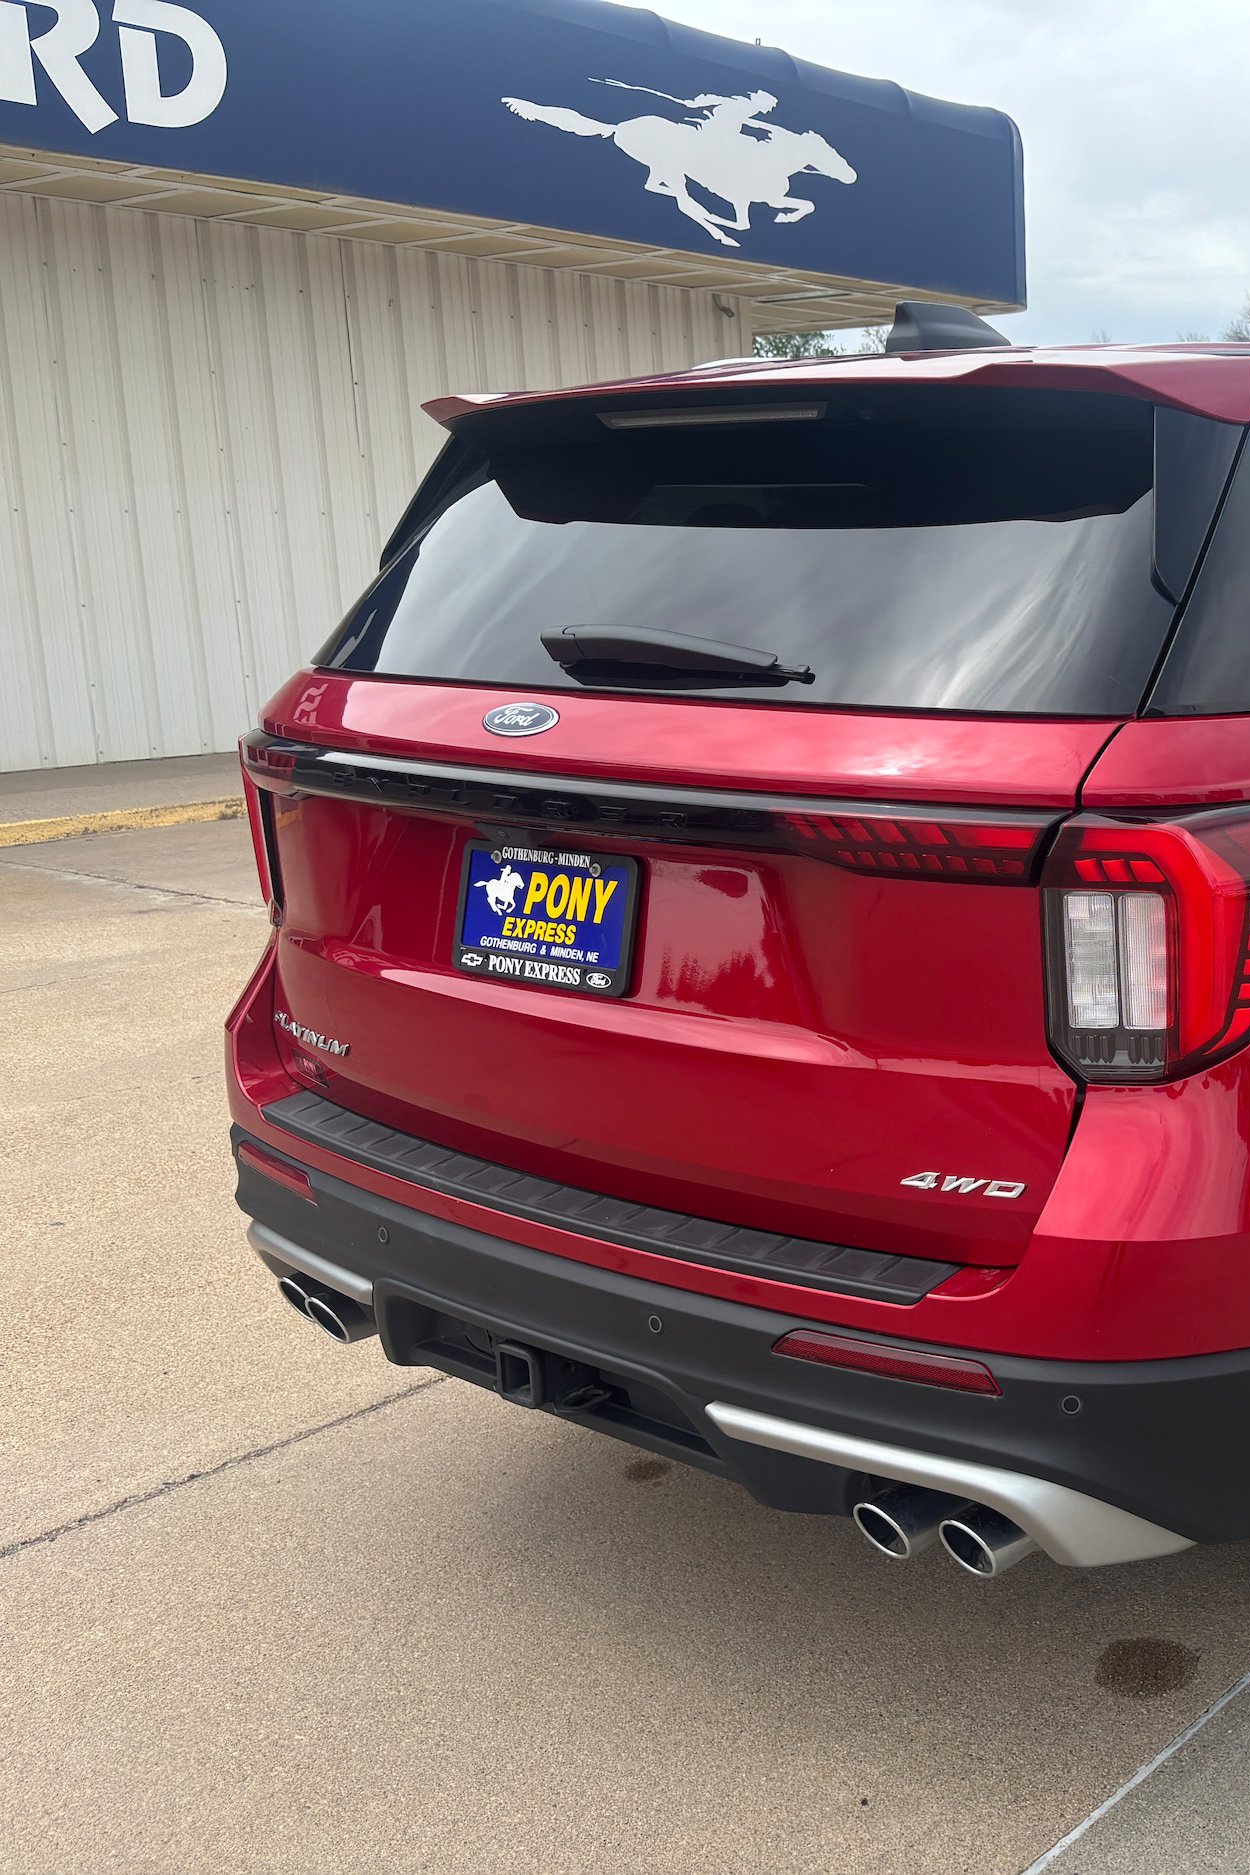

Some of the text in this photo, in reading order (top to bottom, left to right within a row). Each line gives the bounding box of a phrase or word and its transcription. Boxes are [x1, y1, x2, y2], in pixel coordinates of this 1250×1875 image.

[522, 871, 619, 925] PONY
[502, 916, 577, 945] EXPRESS
[479, 936, 600, 963] GOTHENBURG & MINDEN, NE
[488, 954, 581, 985] PONY EXPRESS
[273, 1010, 350, 1057] PLATINUM
[900, 1171, 1027, 1199] 4WD
